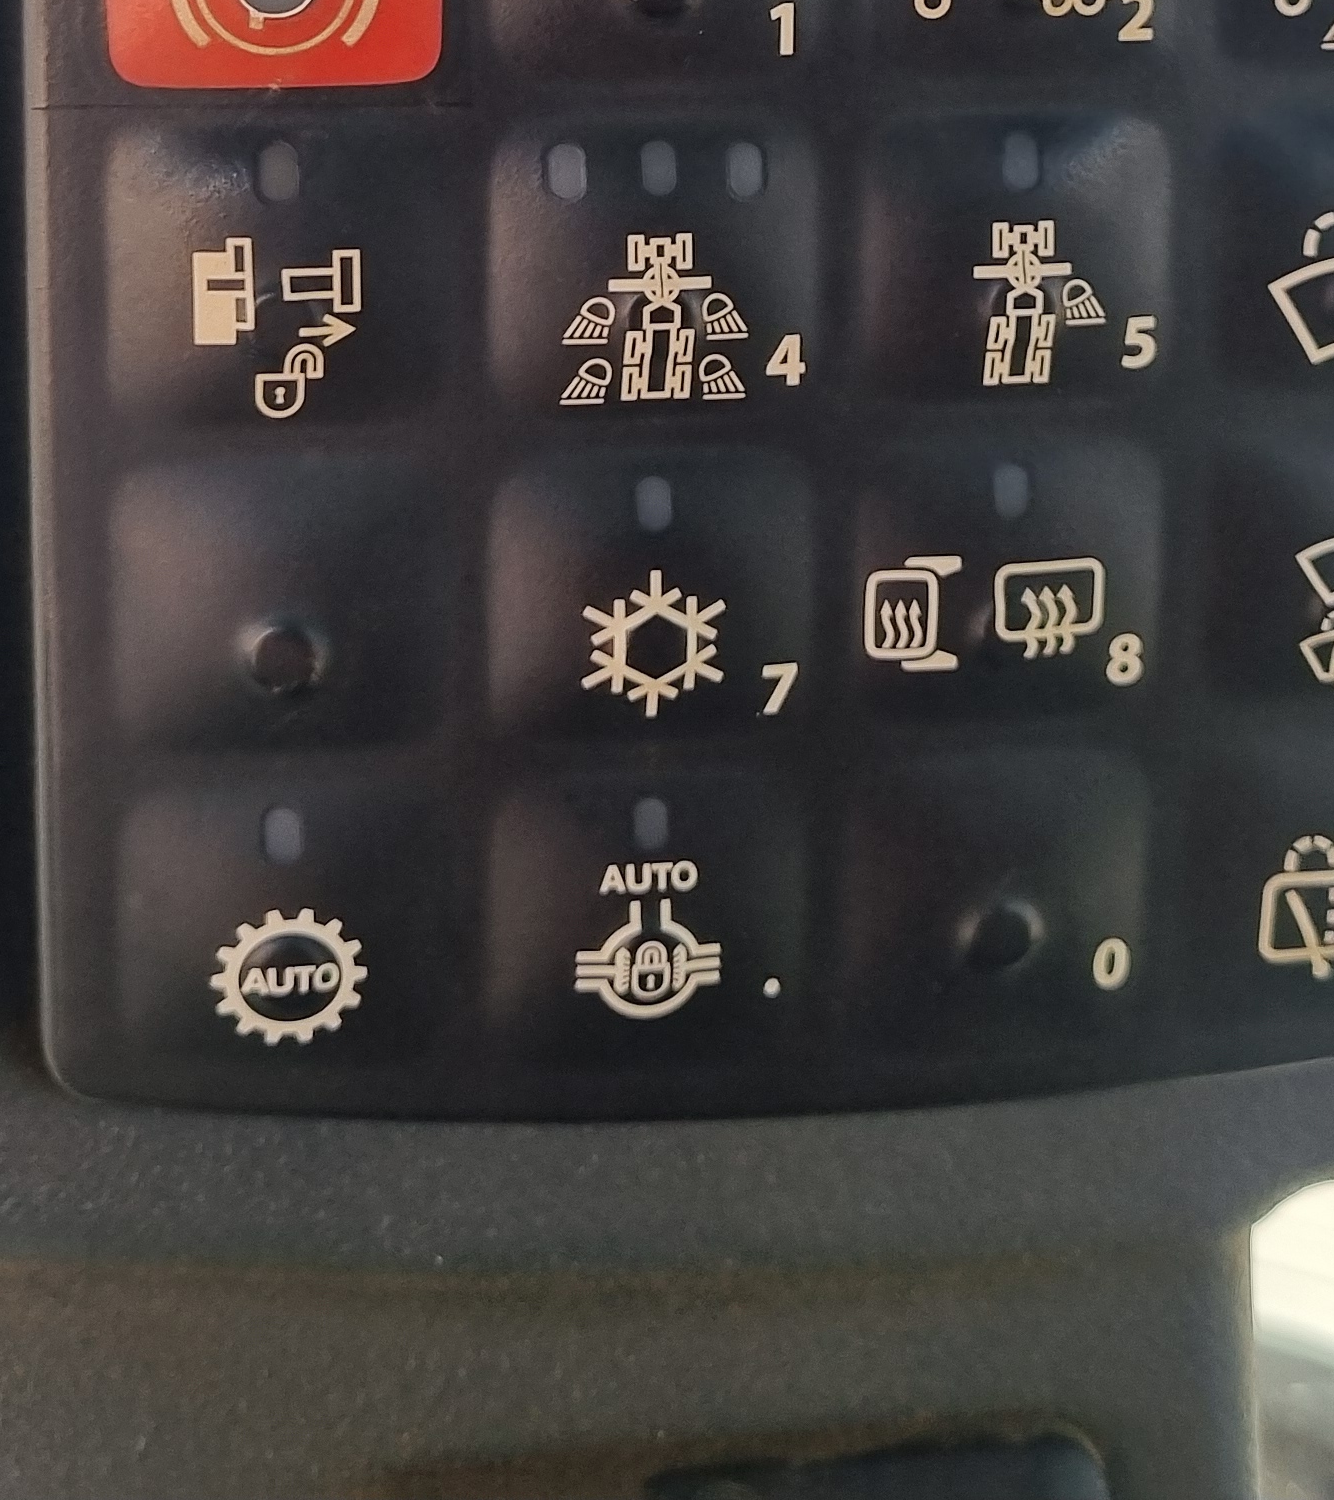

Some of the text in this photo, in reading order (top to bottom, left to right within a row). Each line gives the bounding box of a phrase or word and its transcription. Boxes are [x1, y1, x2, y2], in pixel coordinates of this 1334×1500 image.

[769, 2, 796, 56] 1
[765, 333, 806, 387] 4
[1121, 315, 1158, 369] 5
[1105, 633, 1145, 687] 8
[761, 662, 799, 716] 7
[599, 860, 699, 896] AUTO
[239, 962, 341, 998] AUTO
[1092, 938, 1130, 991] 0
